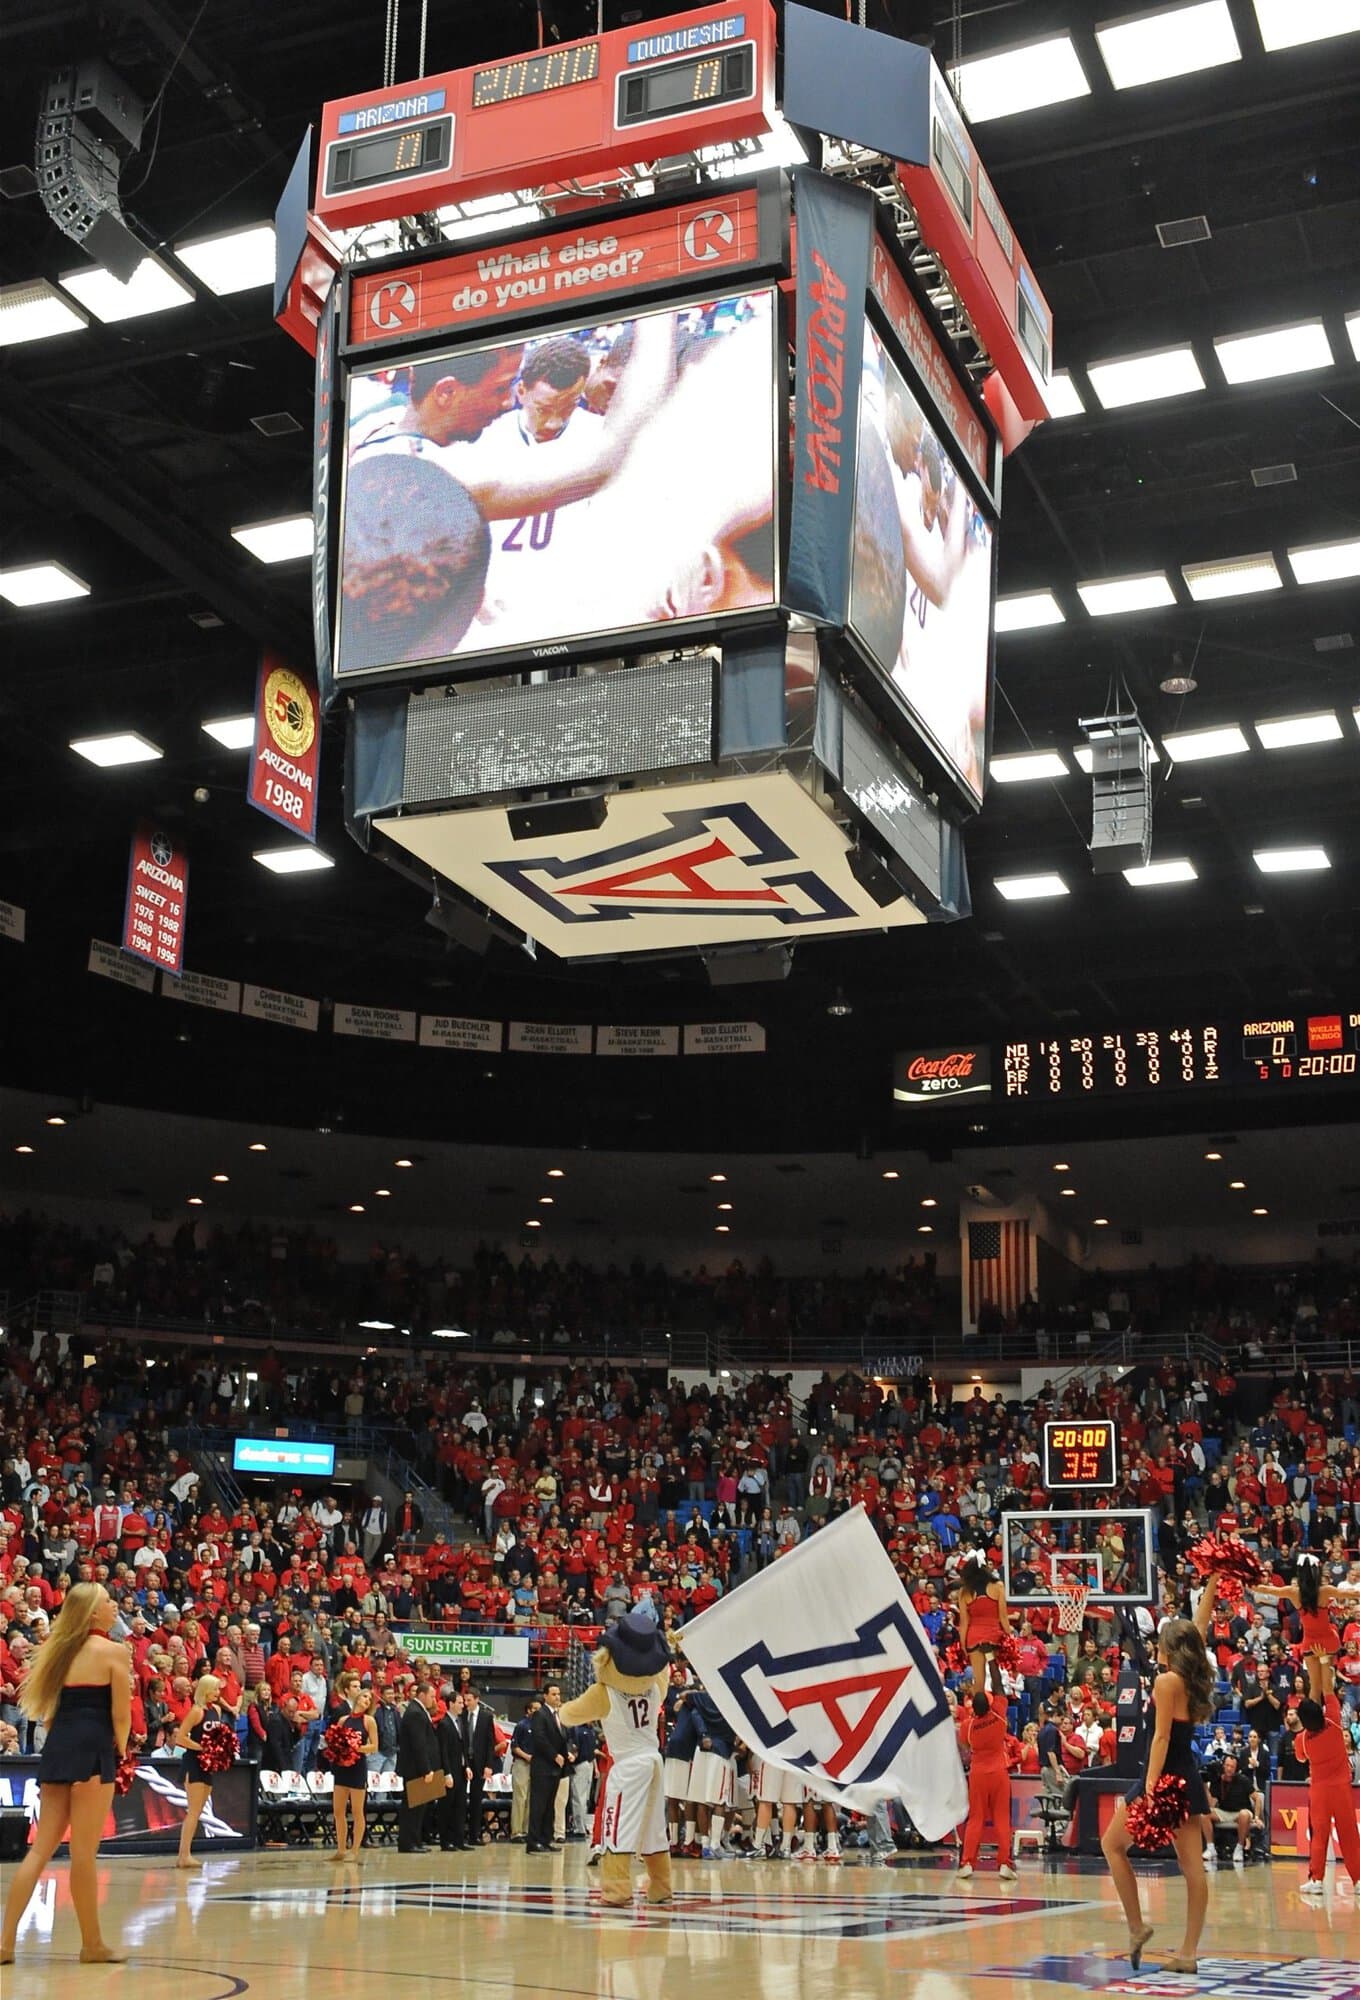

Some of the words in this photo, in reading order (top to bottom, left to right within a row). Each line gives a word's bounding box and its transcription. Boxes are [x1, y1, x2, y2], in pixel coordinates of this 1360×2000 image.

[637, 19, 736, 61] DUQUESNE
[474, 44, 598, 106] 20:00
[692, 60, 720, 100] 0
[355, 96, 428, 130] ARIZONA
[395, 132, 421, 170] 0
[477, 246, 550, 282] What
[559, 237, 619, 265] else
[452, 285, 488, 312] do
[496, 276, 546, 309] you
[554, 249, 645, 289] need?
[806, 248, 846, 495] ARIZONA
[532, 645, 569, 658] VIACOM
[258, 748, 312, 793] ARIZONA
[265, 779, 303, 819] 1988
[136, 859, 184, 893] ARIZONA
[134, 902, 155, 922] 1976
[135, 884, 167, 908] SWEET
[169, 902, 181, 916] 16
[133, 919, 153, 937] 1989
[158, 930, 176, 949] 1991
[131, 934, 152, 953] 1994
[156, 946, 176, 965] 1996
[1040, 1041, 1060, 1055] 14
[1070, 1038, 1092, 1052] 20
[1103, 1035, 1121, 1049] 21
[1136, 1032, 1159, 1046] 33
[1169, 1029, 1192, 1043] 44
[1243, 1020, 1294, 1036] ARIZONA
[1310, 1025, 1341, 1033] WELLS
[1272, 1037, 1285, 1055] 0
[907, 1053, 976, 1080] Coca-Cola
[1299, 1054, 1356, 1076] 20:00
[921, 1076, 961, 1091] zero.
[1053, 1429, 1107, 1448] 20:00
[1062, 1452, 1098, 1478] 35
[406, 1639, 488, 1654] SUNSTREET
[628, 1699, 650, 1729] 12
